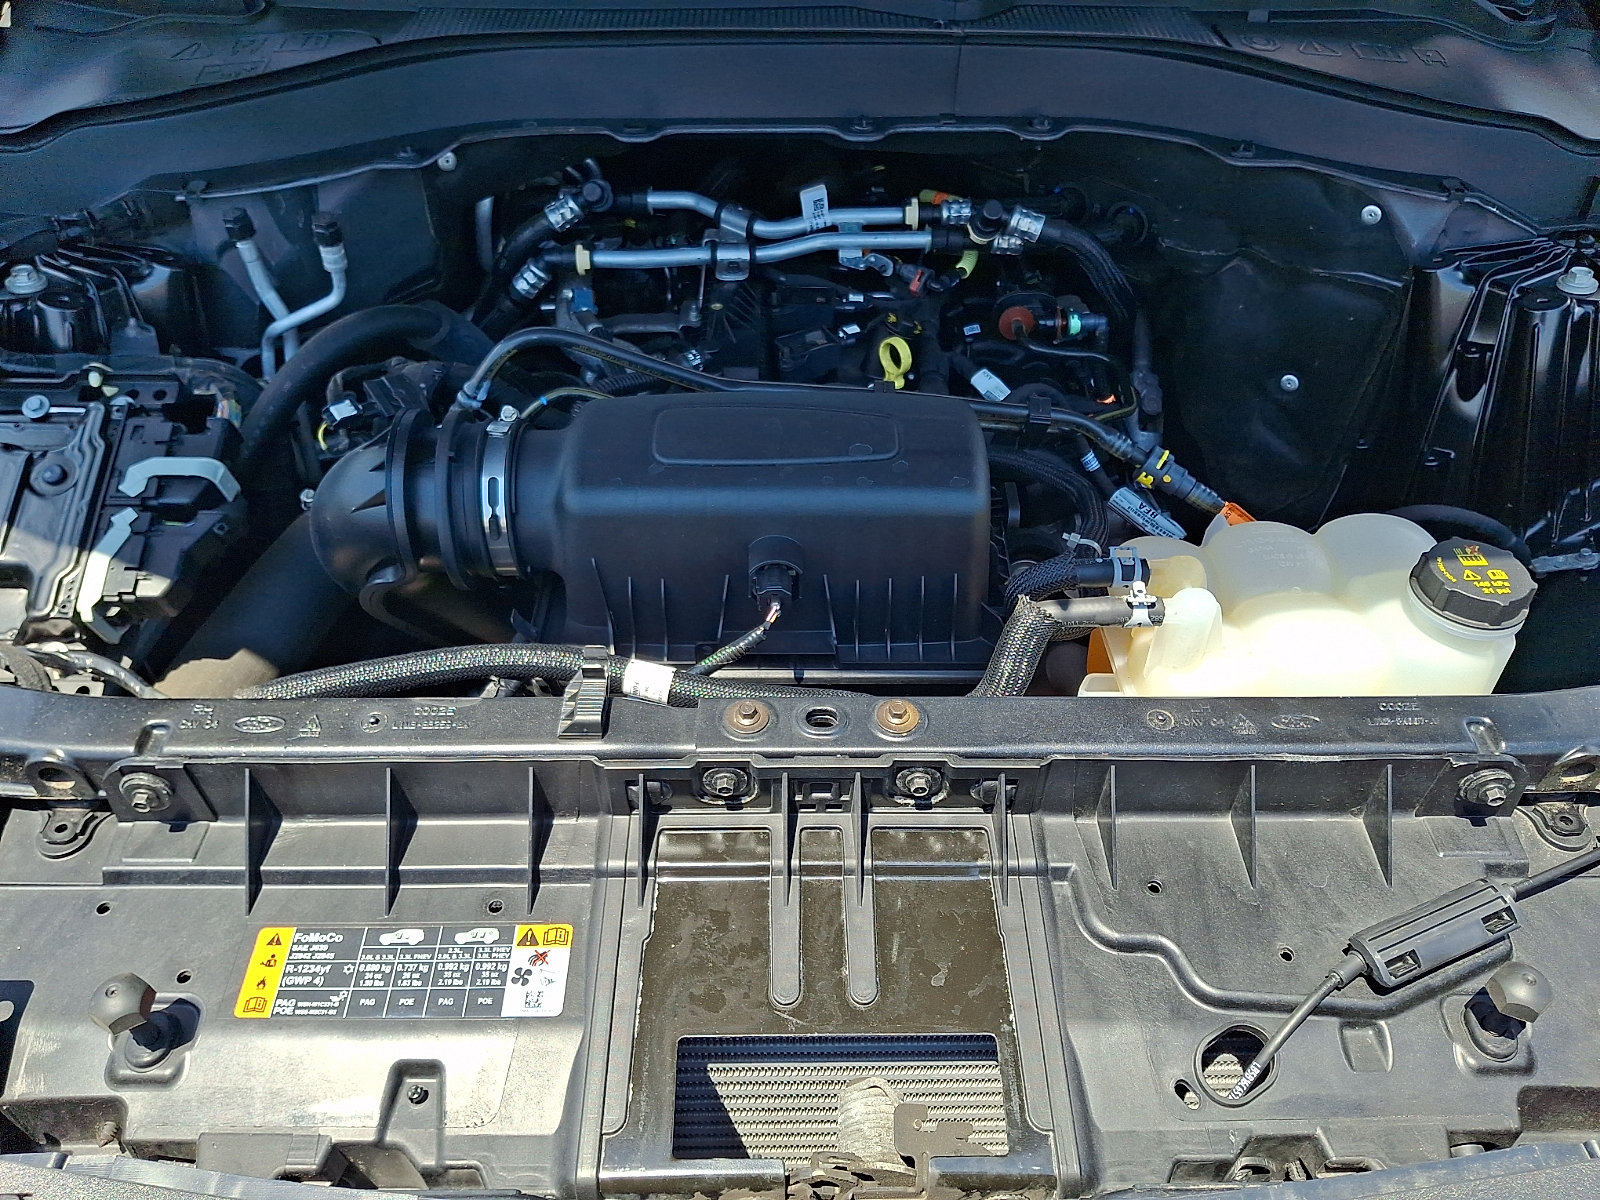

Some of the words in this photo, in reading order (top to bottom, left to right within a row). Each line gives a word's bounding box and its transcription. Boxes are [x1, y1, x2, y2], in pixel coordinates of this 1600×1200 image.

[294, 932, 344, 943] FoMoCo
[286, 964, 332, 975] R-1234yf
[381, 964, 392, 973] kg
[419, 964, 429, 973] kg
[460, 962, 470, 972] kg
[476, 962, 496, 970] 0.992
[497, 962, 508, 972] kg
[282, 976, 312, 987] (GWP
[313, 976, 324, 987] 4)
